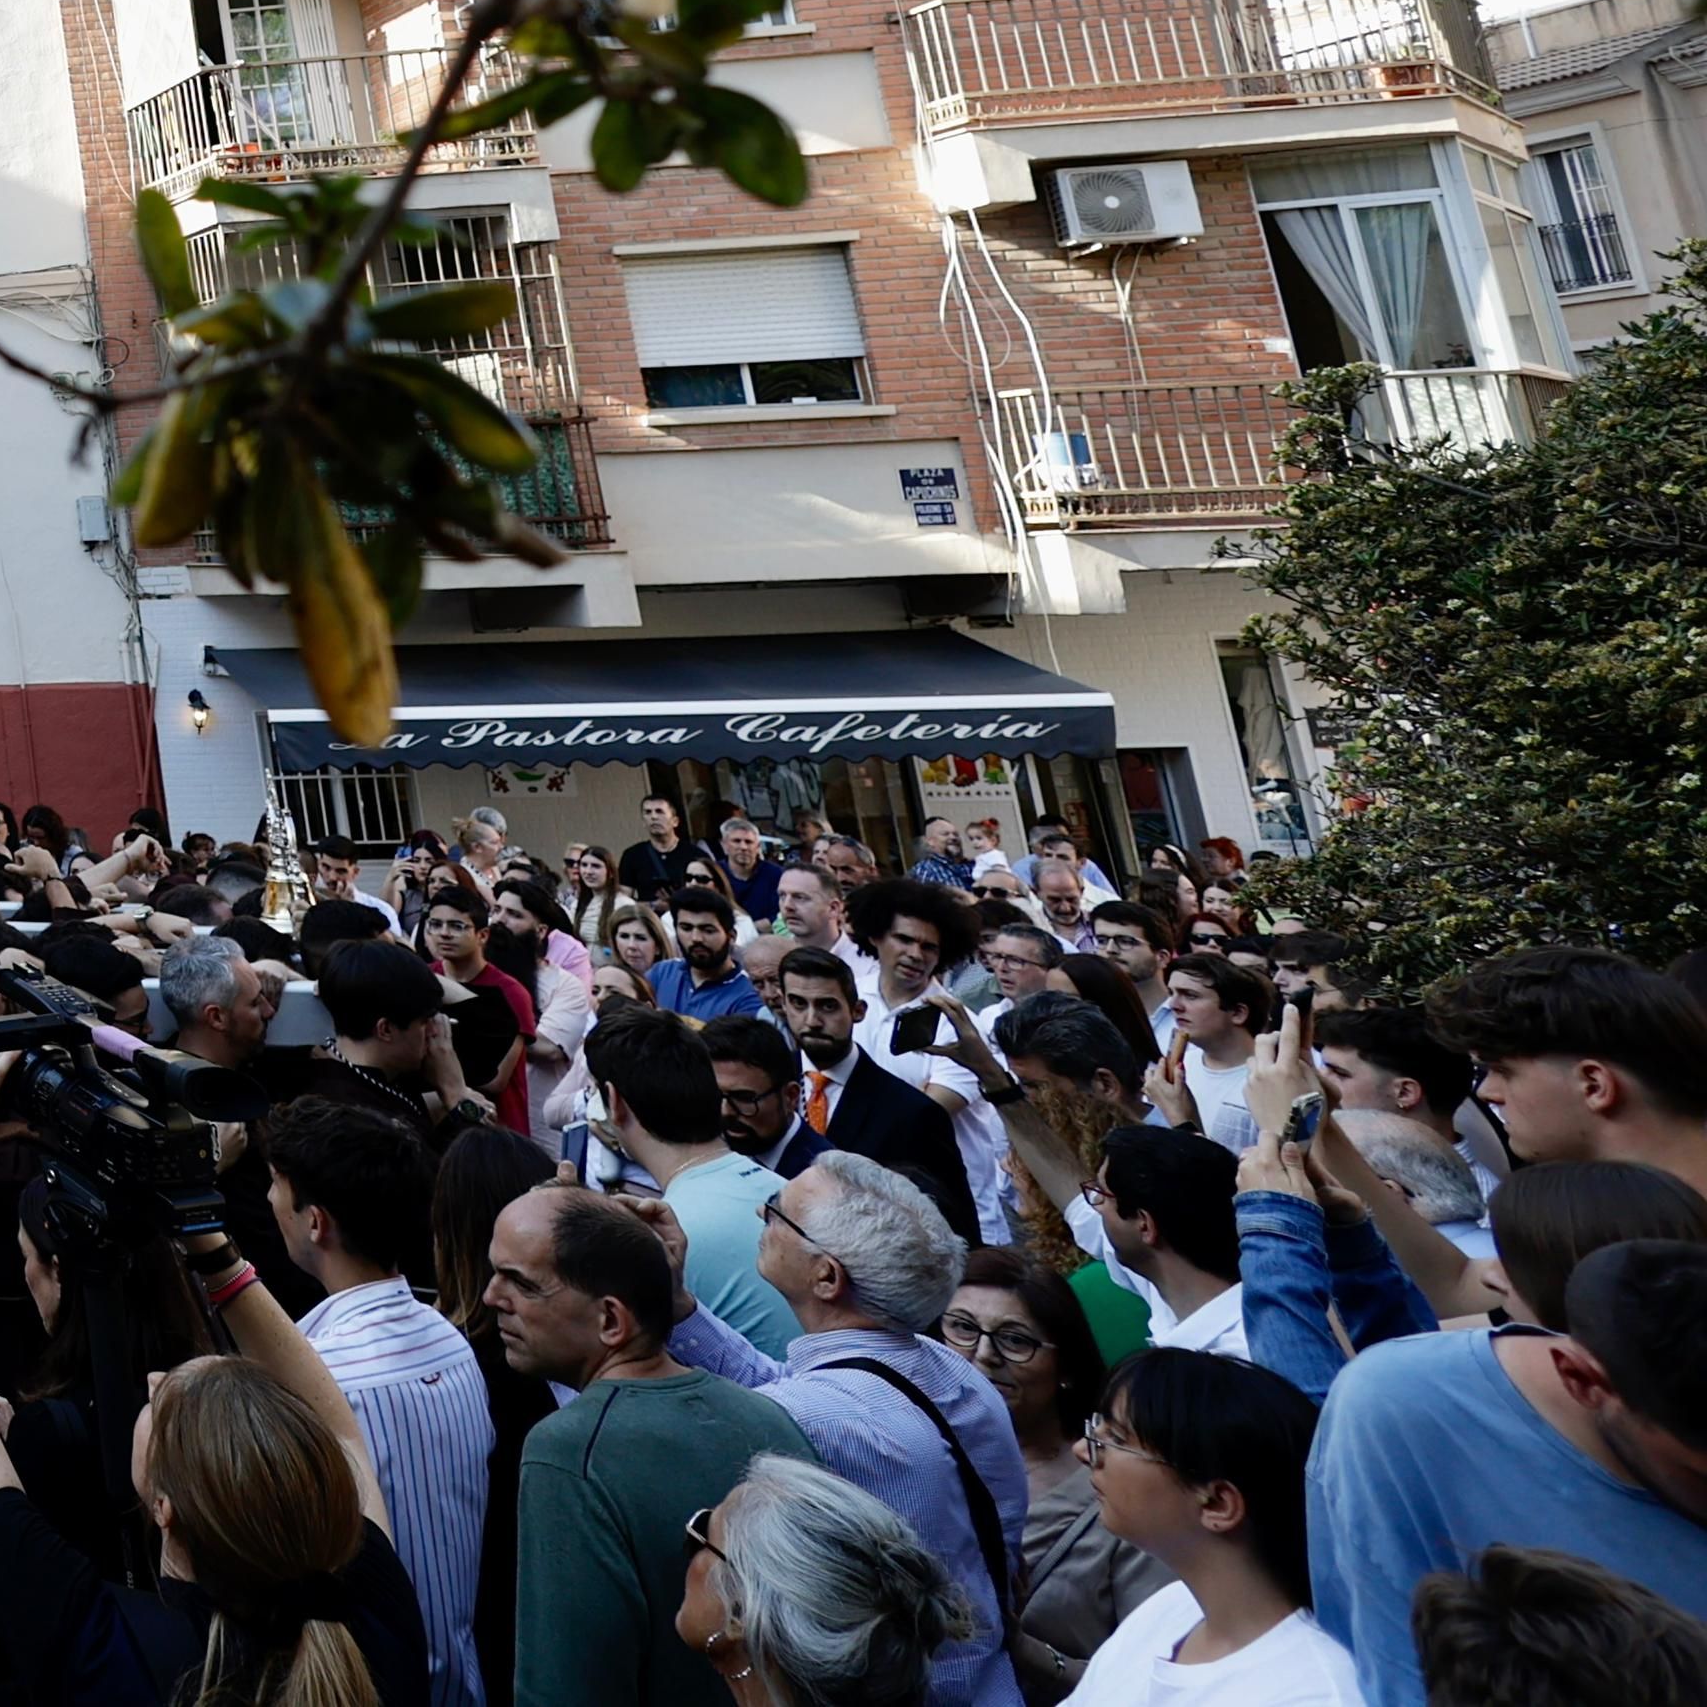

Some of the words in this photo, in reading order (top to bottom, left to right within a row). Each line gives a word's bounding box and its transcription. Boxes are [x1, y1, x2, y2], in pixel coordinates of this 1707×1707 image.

[910, 468, 944, 478] PLAZA
[905, 485, 956, 500] CAPUCHINOS
[441, 719, 705, 748] Pastora
[725, 712, 1061, 754] Cafetería
